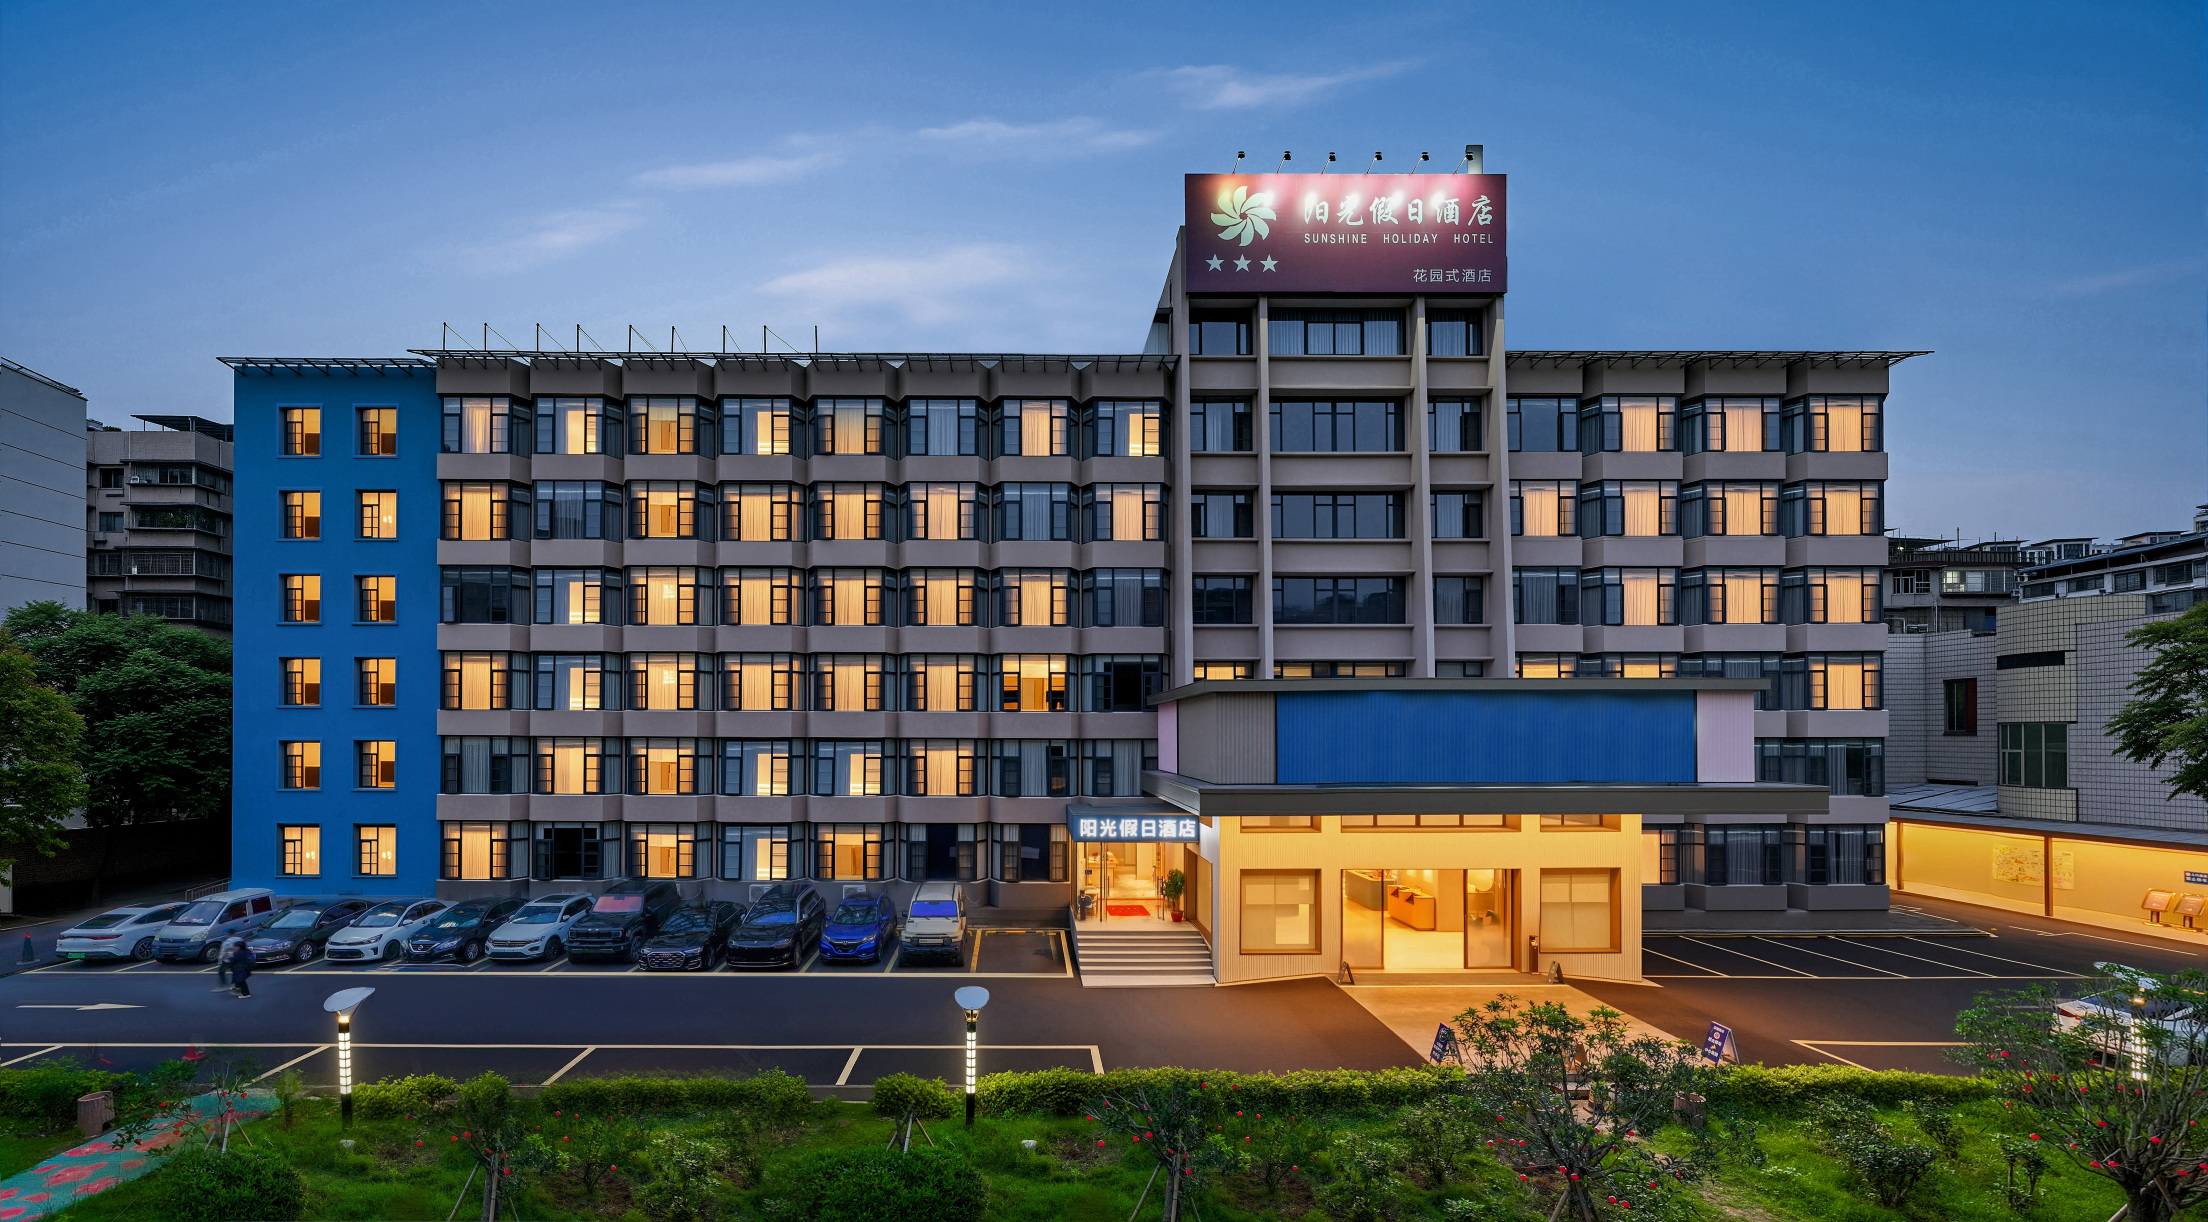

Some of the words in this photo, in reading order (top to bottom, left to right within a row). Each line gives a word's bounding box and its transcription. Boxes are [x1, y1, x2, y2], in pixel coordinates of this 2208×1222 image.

[1303, 194, 1494, 227] 阳光假日酒店
[1304, 233, 1368, 244] SUNSHINE
[1383, 233, 1439, 244] HOLIDAY
[1453, 233, 1494, 244] HOTEL
[1413, 268, 1492, 283] 花园式酒店
[1080, 818, 1196, 838] 阳光假日酒店
